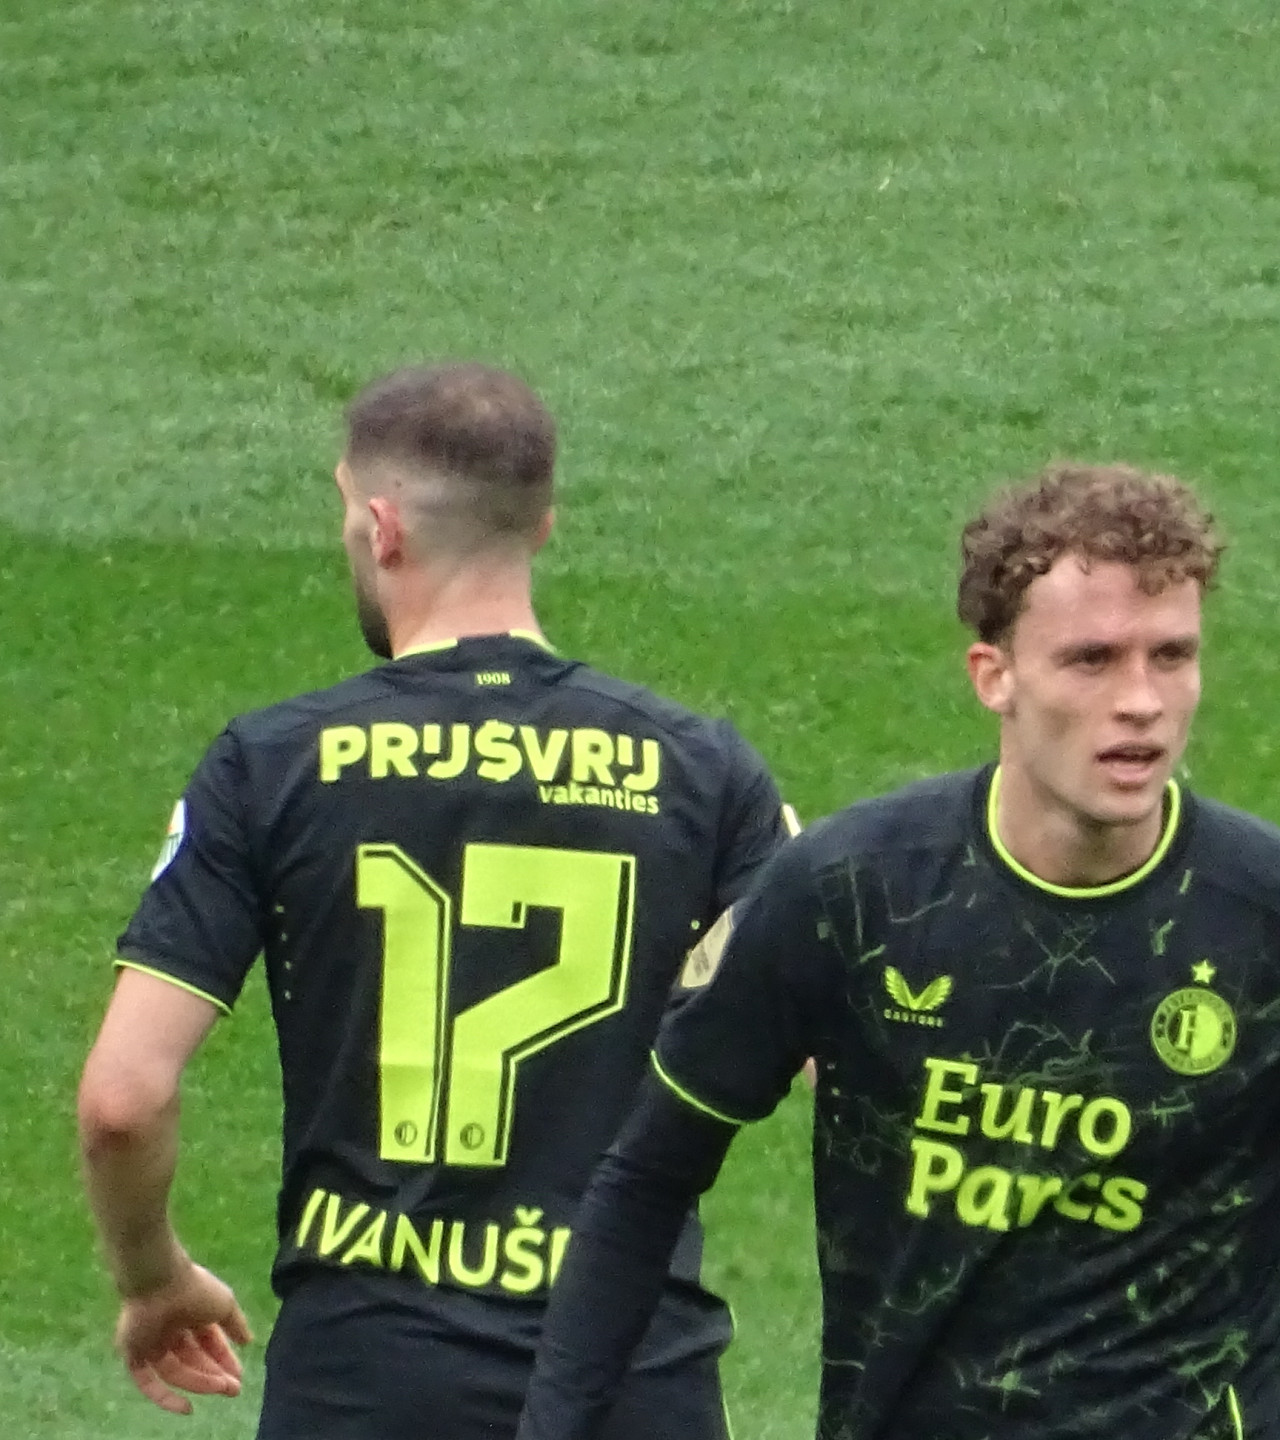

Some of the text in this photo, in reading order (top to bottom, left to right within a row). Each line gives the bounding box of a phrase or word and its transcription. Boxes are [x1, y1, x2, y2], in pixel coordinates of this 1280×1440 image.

[476, 671, 512, 686] 1908
[539, 780, 660, 815] vakanties
[356, 842, 637, 1168] 17
[914, 1056, 1133, 1158] Euro
[905, 1137, 1149, 1233] Parcs
